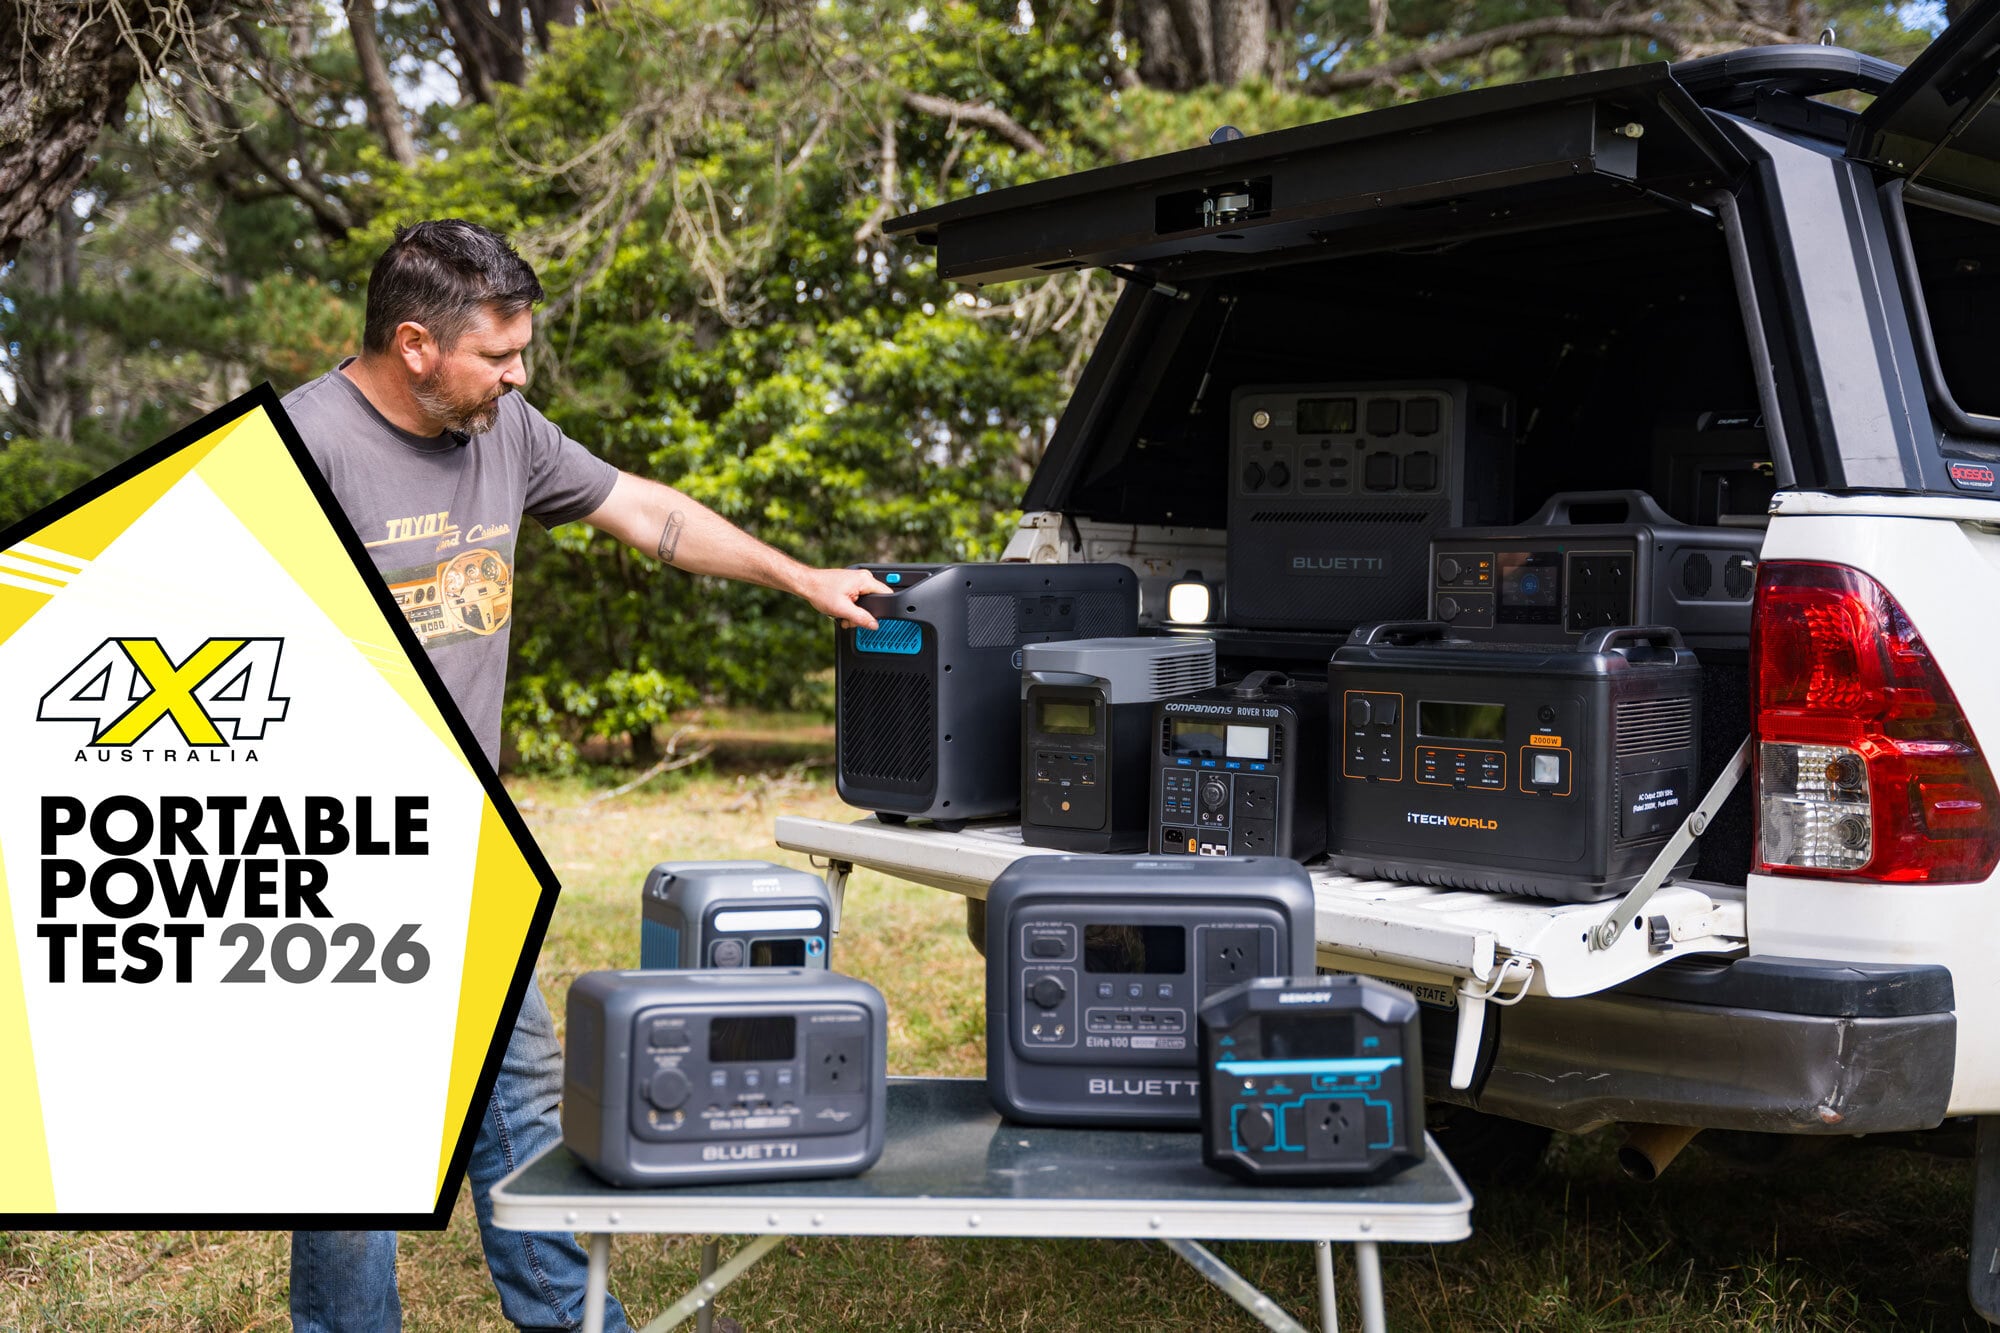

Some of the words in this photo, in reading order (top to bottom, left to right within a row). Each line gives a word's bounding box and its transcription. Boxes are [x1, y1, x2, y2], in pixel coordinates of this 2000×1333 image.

[1292, 557, 1382, 570] BLUETTI
[1237, 707, 1260, 717] ROVER
[1262, 709, 1279, 718] 1300
[1533, 736, 1558, 745] 2000W
[1415, 986, 1447, 1002] STATE
[1086, 1037, 1111, 1048] Elite
[1111, 1037, 1129, 1048] 100
[702, 1143, 798, 1161] BLUETTI
